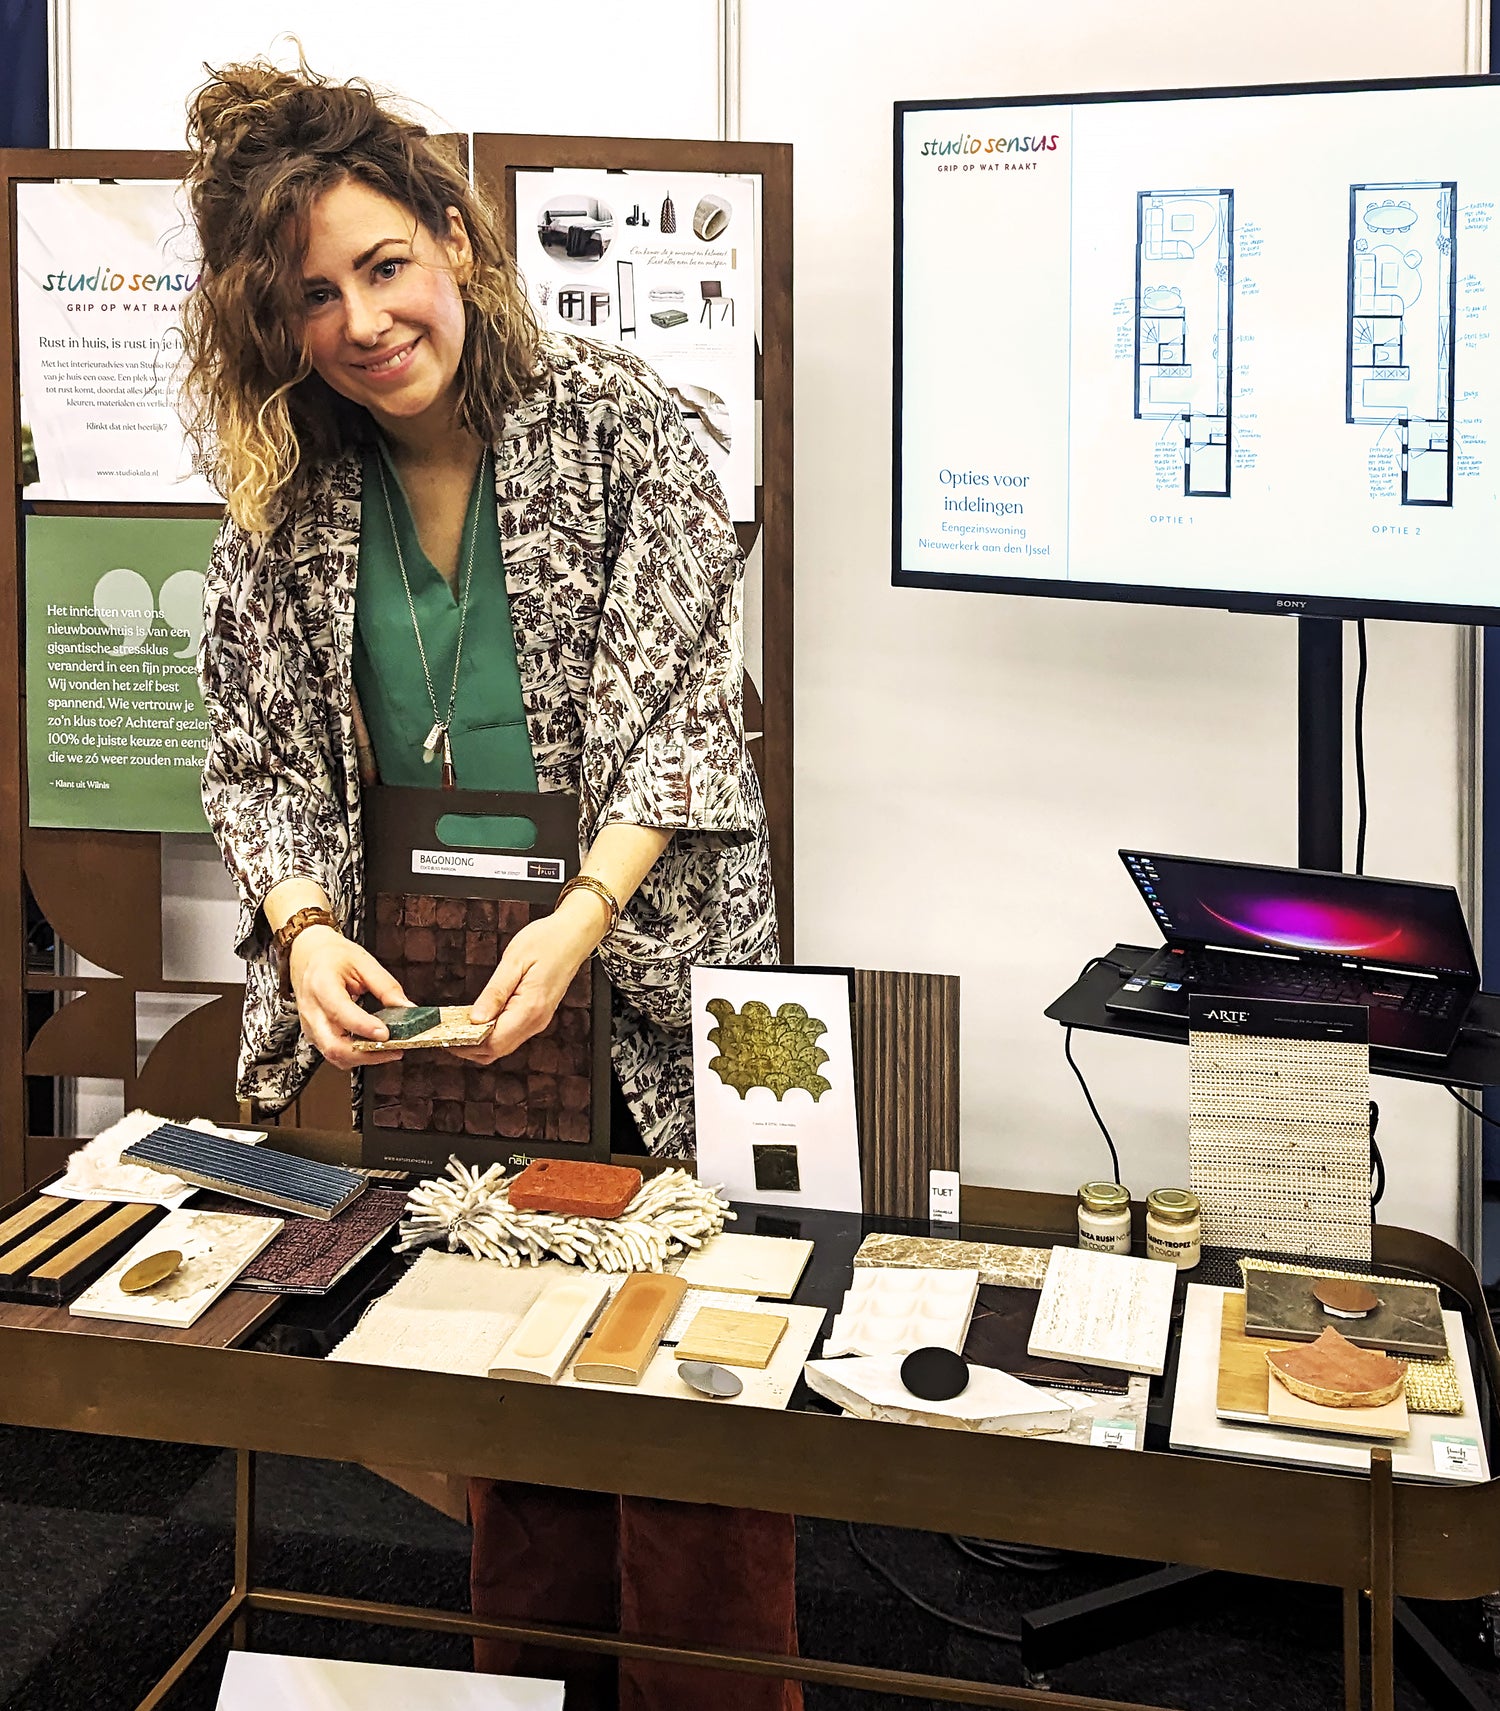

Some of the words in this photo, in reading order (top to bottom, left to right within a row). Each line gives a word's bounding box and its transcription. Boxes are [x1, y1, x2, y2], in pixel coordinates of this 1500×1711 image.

[921, 133, 982, 156] studio
[984, 135, 1059, 153] sensus
[963, 164, 975, 172] OP
[980, 163, 999, 171] WAT
[1004, 162, 1037, 171] RAAKT
[43, 266, 125, 291] studio
[128, 273, 201, 291] sensu
[67, 304, 94, 312] GRIP
[101, 304, 116, 312] OP
[123, 304, 147, 312] WAT
[39, 337, 65, 348] Rust
[69, 338, 79, 348] in
[82, 337, 109, 349] huis,
[112, 338, 121, 349] is
[124, 339, 147, 349] rust
[150, 339, 159, 349] in
[41, 360, 56, 368] Met
[57, 360, 69, 368] het
[46, 386, 57, 394] tot
[86, 422, 108, 430] Klinkt
[109, 422, 121, 430] dat
[123, 423, 136, 431] niet
[138, 424, 167, 432] heerlijk?
[939, 469, 989, 488] Opties
[993, 475, 1030, 487] voor
[944, 496, 1023, 516] indelingen
[1150, 515, 1184, 524] OPTIE
[942, 521, 1026, 539] Eengezinswoning
[1372, 525, 1408, 535] OPTIE
[1415, 527, 1421, 536] 2
[918, 538, 979, 551] Nieuwerkerk
[982, 544, 1001, 552] aan
[1003, 543, 1022, 553] den
[1276, 600, 1307, 608] SONY
[47, 605, 67, 616] Het
[70, 606, 118, 618] inrichten
[121, 609, 142, 618] van
[144, 610, 164, 619] ons
[47, 623, 133, 636] nieuwbouwhuis
[136, 625, 145, 636] is
[147, 628, 168, 637] van
[170, 628, 190, 637] een
[47, 642, 110, 655] gigantische
[113, 643, 169, 655] stressklus
[48, 660, 104, 672] veranderd
[106, 661, 117, 672] in
[120, 664, 140, 673] een
[142, 661, 160, 675] fijn
[47, 678, 67, 691] Wij
[69, 678, 110, 691] vonden
[112, 679, 131, 691] het
[133, 679, 154, 692] zelf
[155, 681, 180, 692] best
[48, 698, 105, 710] spannend.
[107, 697, 130, 709] Wie
[131, 701, 182, 711] vertrouw
[184, 700, 195, 713] je
[73, 715, 96, 727] klus
[98, 716, 123, 728] toe?
[125, 717, 174, 729] Achteraf
[48, 733, 79, 745] 100%
[81, 734, 95, 745] de
[96, 734, 128, 748] juiste
[130, 735, 162, 747] keuze
[165, 738, 178, 748] en
[48, 751, 65, 763] die
[67, 754, 83, 763] we
[101, 754, 128, 765] weer
[130, 754, 171, 766] zouden
[55, 780, 74, 788] Klant
[76, 781, 86, 789] uit
[86, 780, 110, 789] Wilnis
[420, 854, 474, 867] BAGONJONG
[1203, 1010, 1248, 1023] ARTE
[932, 1188, 953, 1196] TUET
[1096, 1232, 1115, 1243] RUSH
